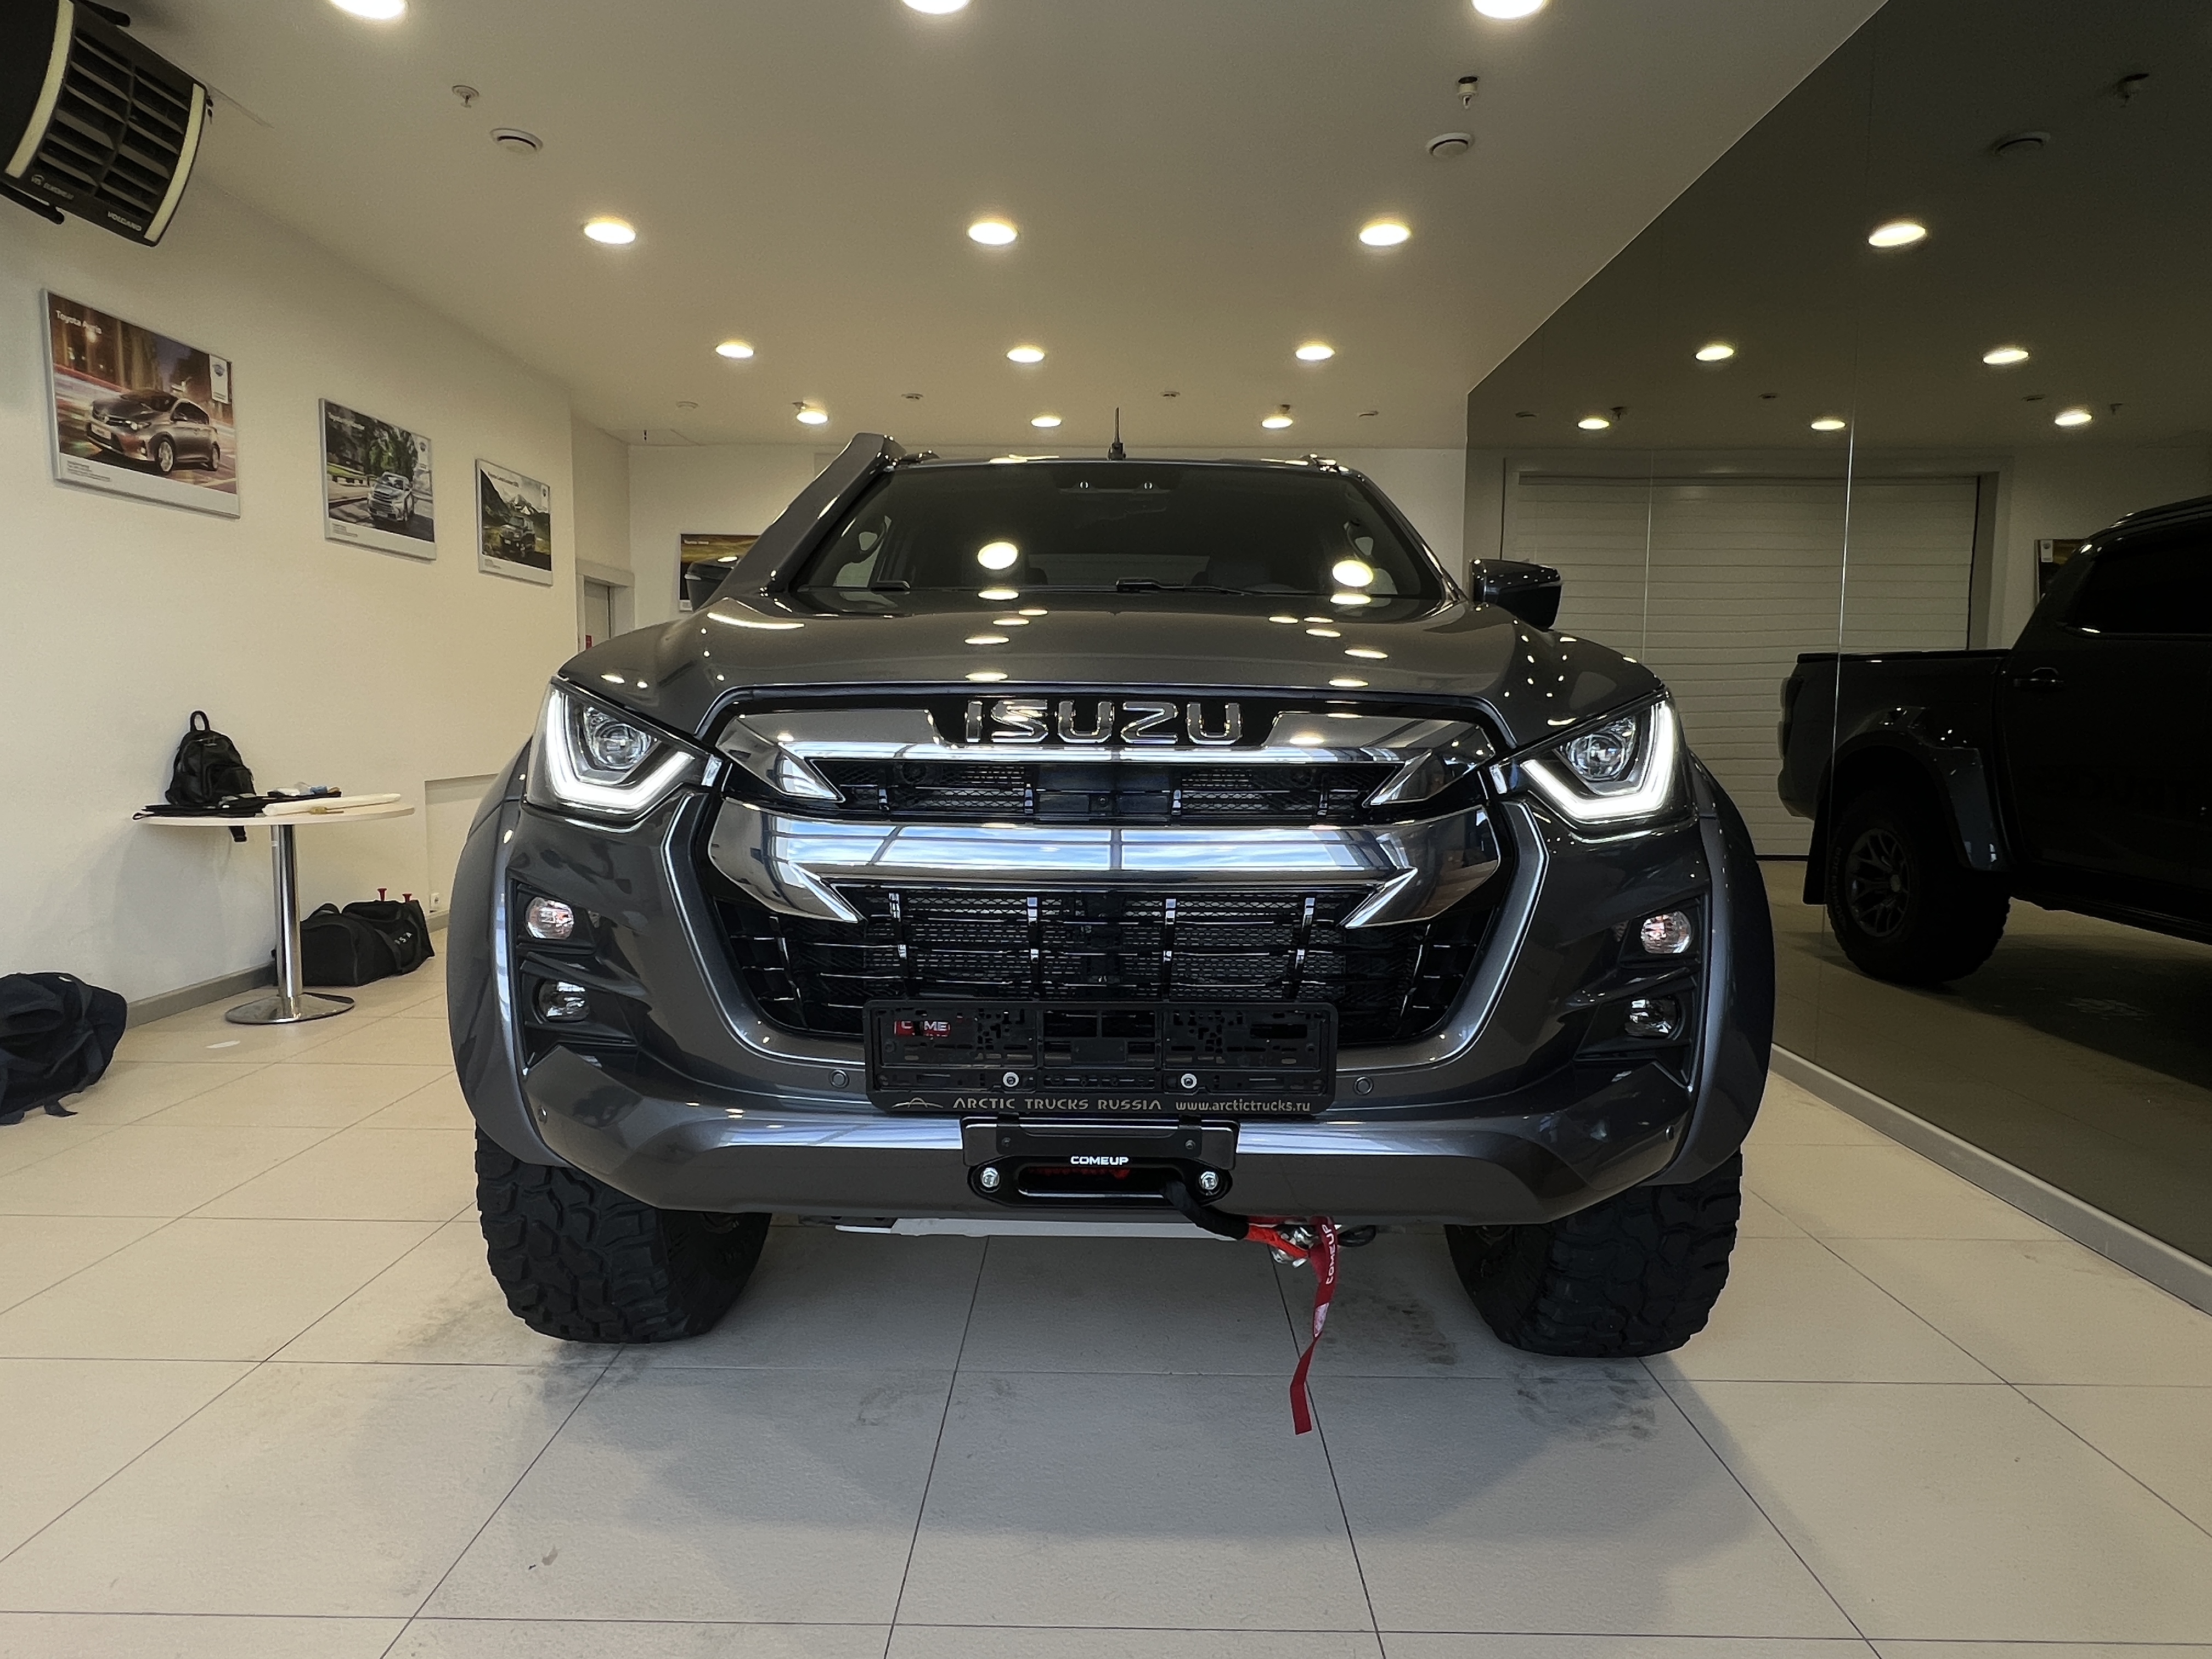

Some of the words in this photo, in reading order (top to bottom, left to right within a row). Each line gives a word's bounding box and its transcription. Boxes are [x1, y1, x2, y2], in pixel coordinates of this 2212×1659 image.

[56, 310, 81, 326] Toyota
[965, 699, 1242, 744] ISUZU
[952, 1097, 1016, 1109] ARCTIC
[1024, 1098, 1089, 1110] TRUCKS
[1097, 1099, 1163, 1110] RUSSIA
[1175, 1098, 1311, 1112] www.arctictrucks.ru
[1070, 1155, 1129, 1165] COMEUP
[1321, 1224, 1335, 1285] COMEUP
